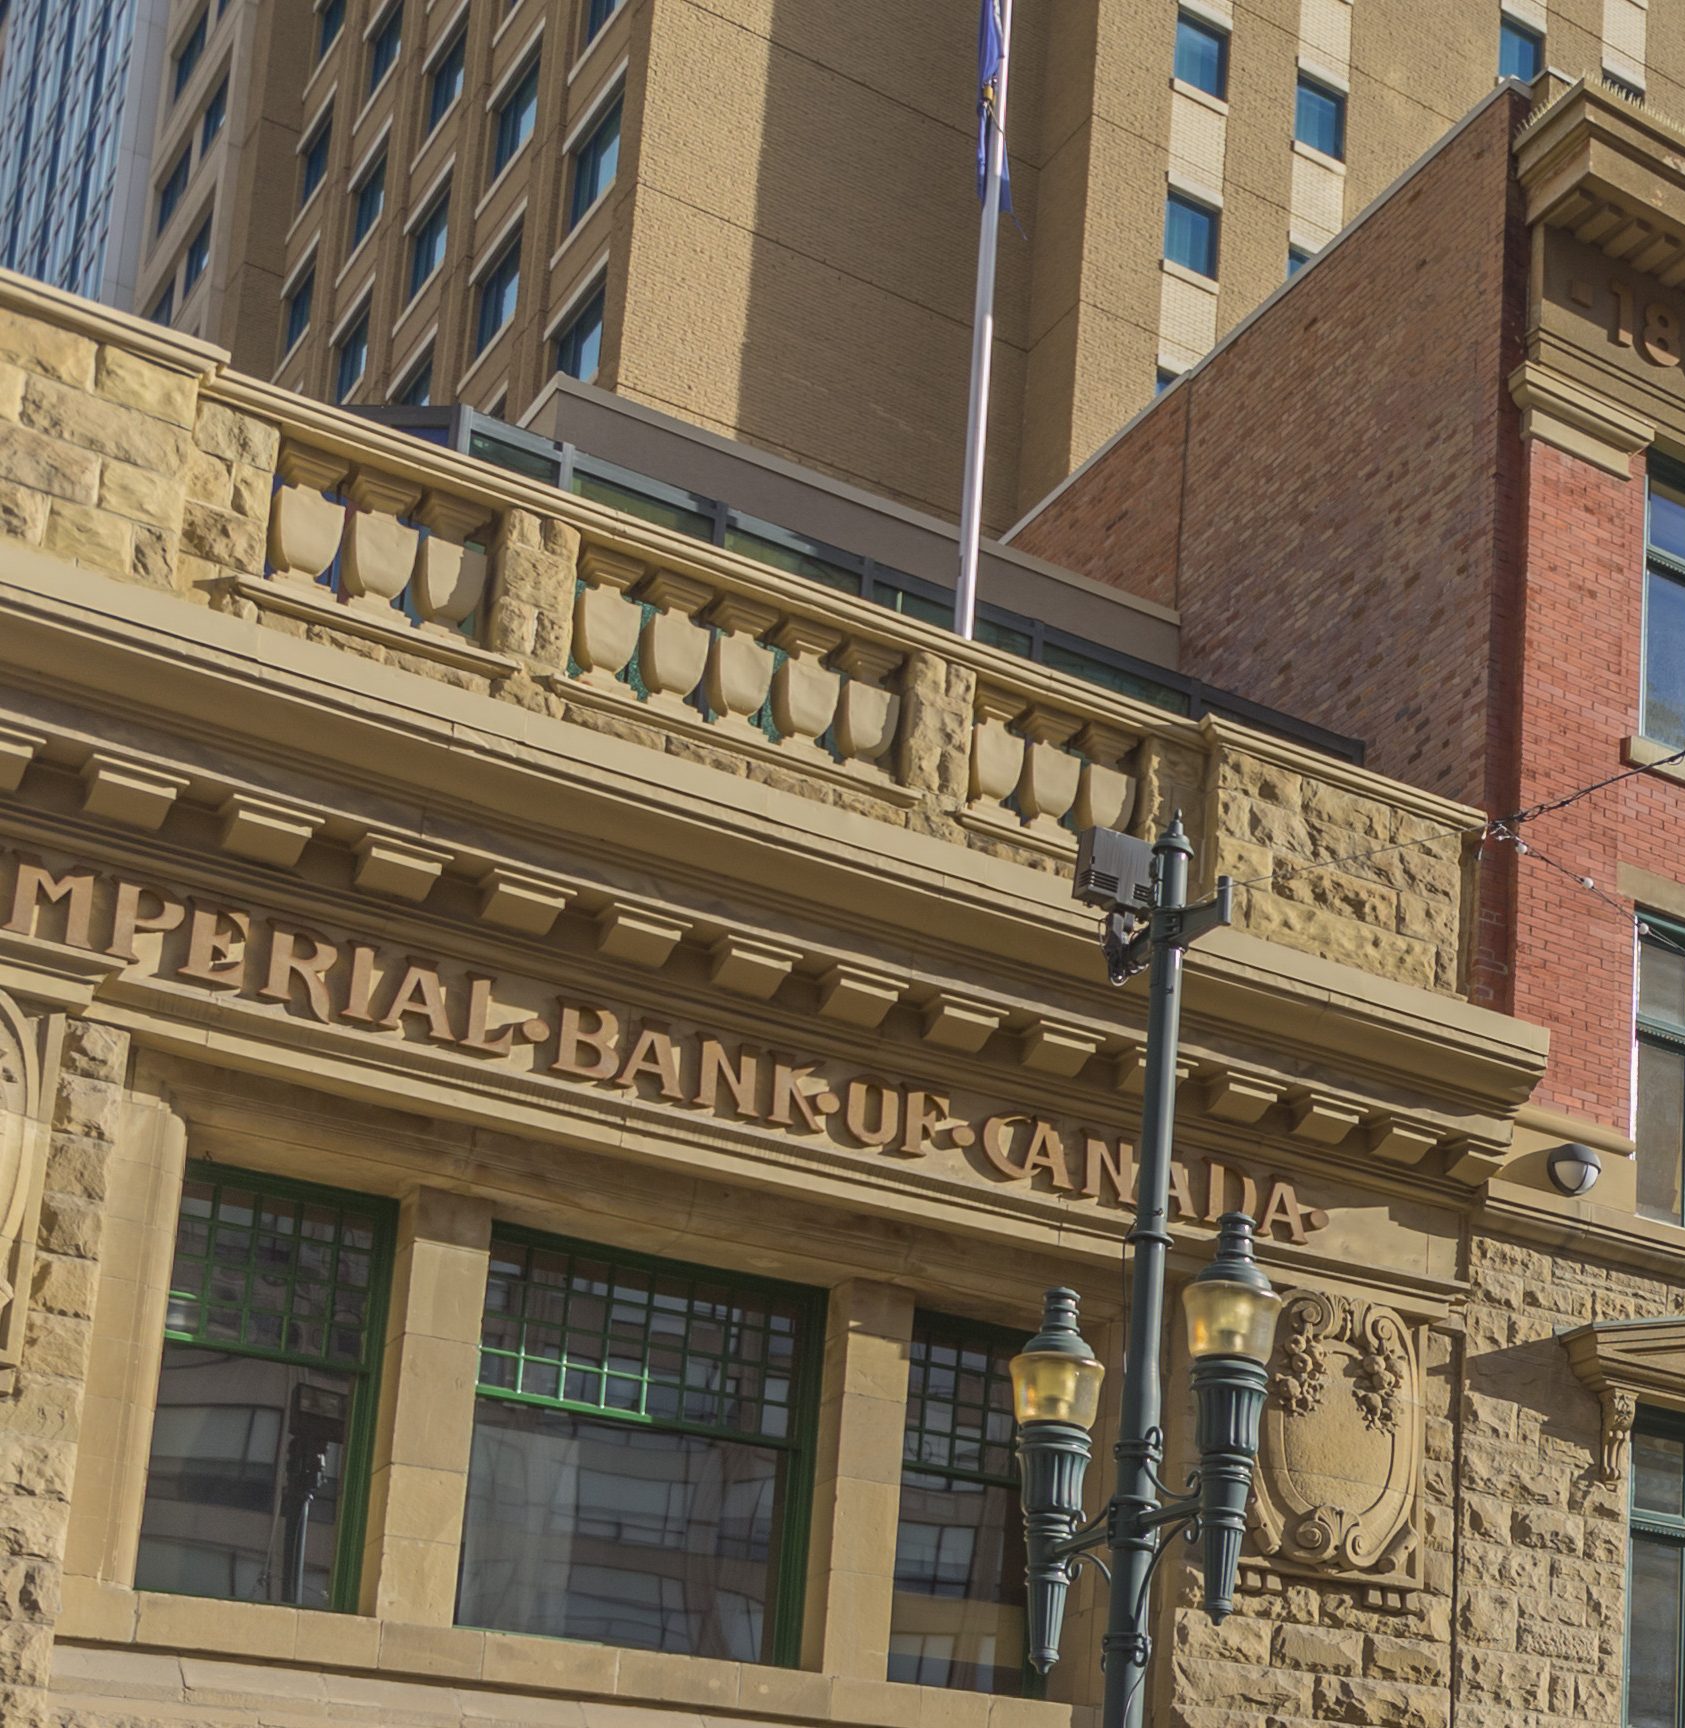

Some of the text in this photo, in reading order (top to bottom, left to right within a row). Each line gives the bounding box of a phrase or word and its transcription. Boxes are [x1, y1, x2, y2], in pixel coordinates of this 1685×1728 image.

[1, 848, 1308, 1246] MPERIAL BANK OF CANADA
